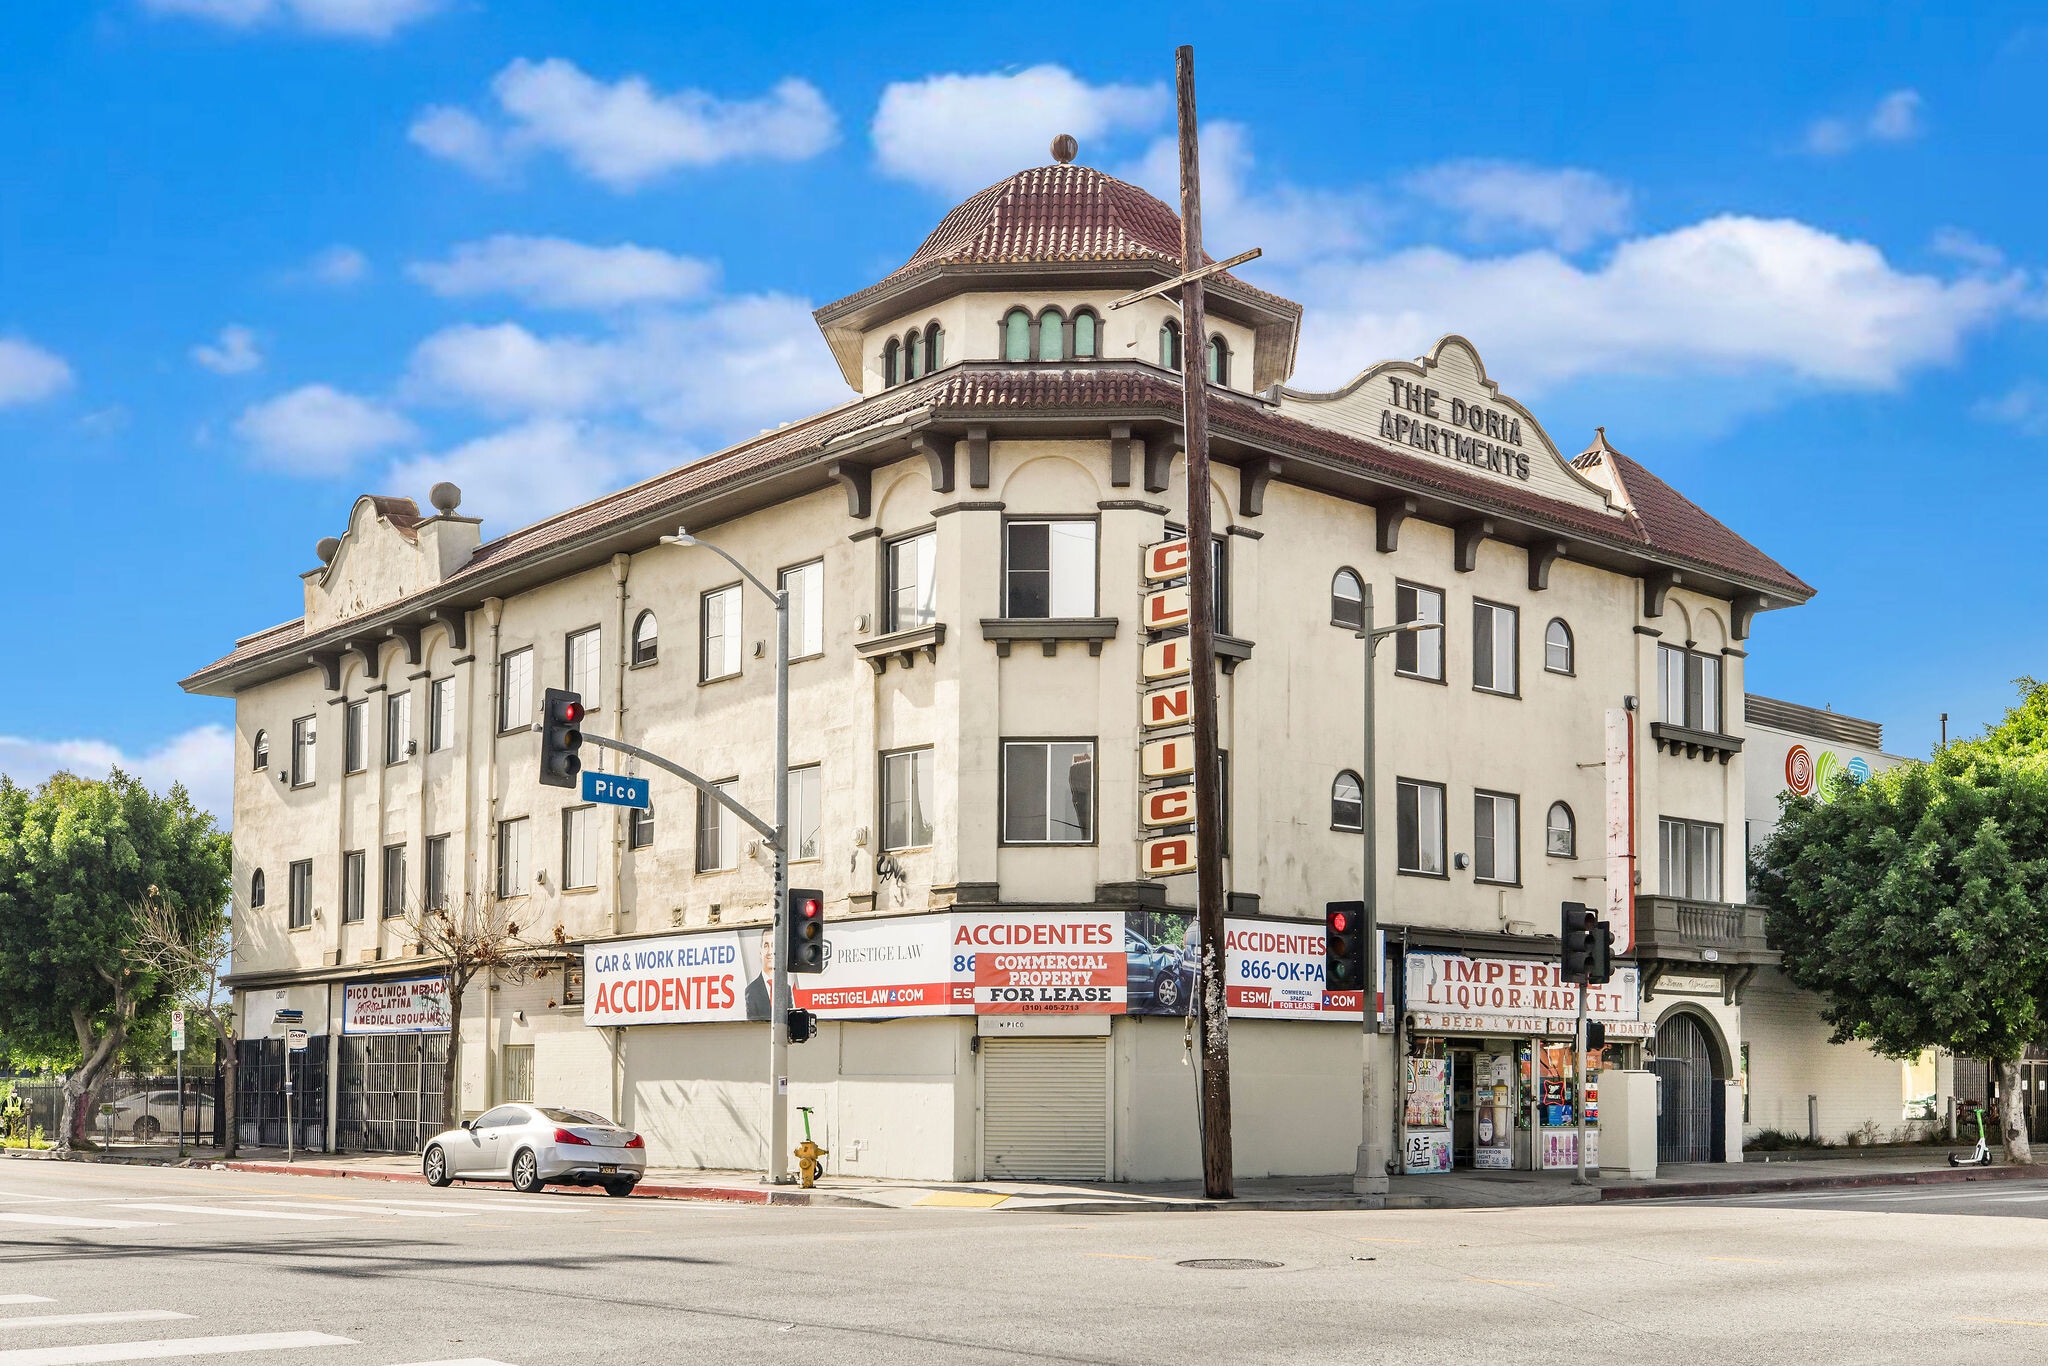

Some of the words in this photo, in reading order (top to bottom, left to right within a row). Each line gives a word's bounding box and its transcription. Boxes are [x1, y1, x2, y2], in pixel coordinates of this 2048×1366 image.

[1388, 376, 1440, 419] THE
[1453, 397, 1522, 447] DORIA
[1381, 410, 1530, 481] APARTMENTS
[595, 780, 636, 800] Pico
[954, 924, 1113, 945] ACCIDENTES
[1225, 930, 1327, 956] ACCIDENTES
[596, 954, 619, 973] CAR
[623, 953, 631, 971] &
[635, 950, 674, 970] WORK
[678, 945, 735, 966] RELATED
[838, 945, 895, 964] PRESTIGE
[897, 944, 922, 960] LAW
[994, 955, 1108, 970] COMMERCIAL
[1009, 971, 1093, 986] PROPERTY
[1443, 960, 1603, 991] IMPERI
[347, 986, 368, 999] PICO
[371, 985, 407, 999] CLINICA
[594, 974, 735, 1014] ACCIDENTES
[990, 988, 1035, 1002] FOR
[1040, 988, 1111, 1002] LEASE
[1427, 983, 1522, 1010] LIQUOR
[381, 998, 411, 1009] LATINA
[1022, 1004, 1042, 1012] (310)
[1294, 1002, 1315, 1010] LEASE
[353, 1015, 358, 1024] A
[359, 1014, 394, 1025] MEDICAL
[396, 1013, 424, 1024] GROUP
[1441, 1016, 1483, 1028] BEER
[1506, 1019, 1542, 1031] WINE
[1620, 1023, 1650, 1034] DAIRY
